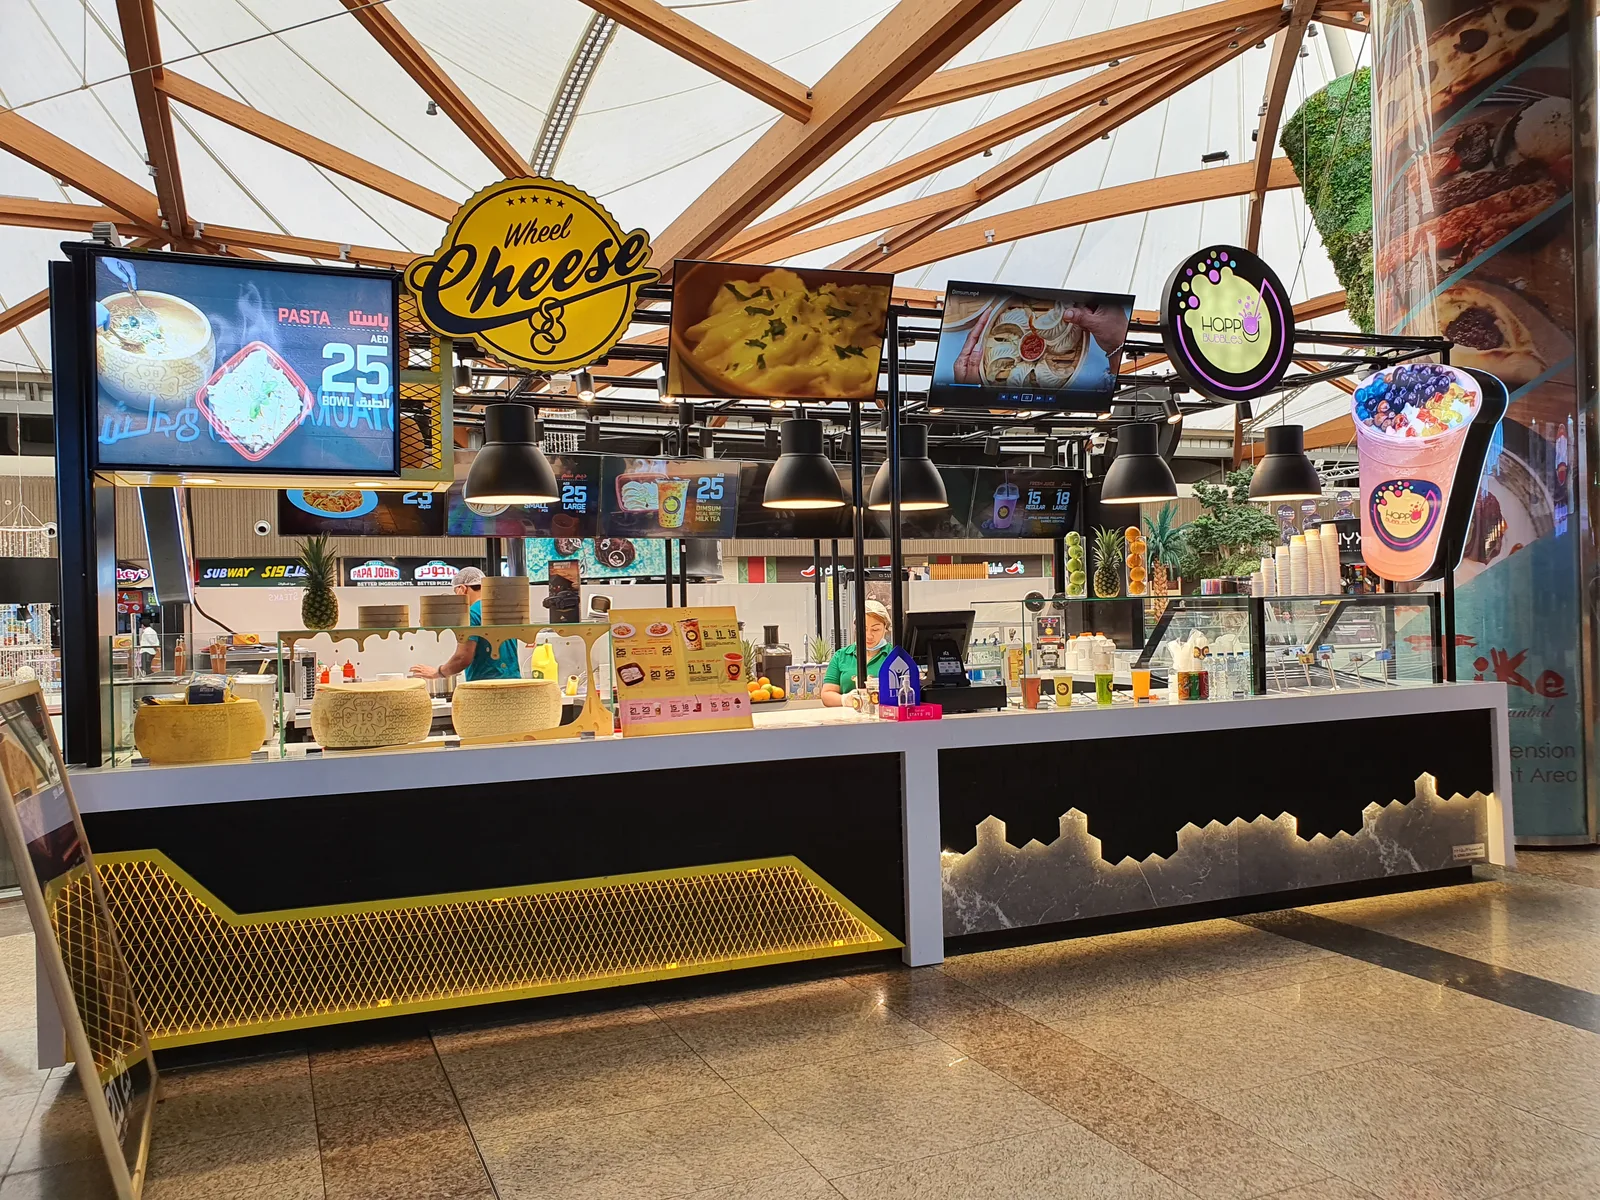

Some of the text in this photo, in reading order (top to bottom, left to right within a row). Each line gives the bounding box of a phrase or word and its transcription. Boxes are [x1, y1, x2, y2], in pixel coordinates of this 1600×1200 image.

[504, 213, 574, 249] Wheel
[410, 233, 655, 334] Cheese
[278, 307, 331, 326] PASTA
[370, 334, 389, 344] AED
[322, 342, 390, 395] 25
[322, 394, 354, 407] BOWL
[562, 485, 588, 503] 25
[697, 477, 725, 500] 25
[1027, 491, 1042, 505] 15
[1056, 491, 1071, 505] 18
[203, 567, 255, 578] SUBWAY
[353, 567, 372, 578] PAPA
[728, 629, 736, 637] 15
[616, 648, 627, 656] 25
[662, 646, 672, 654] 23
[665, 669, 675, 677] 25
